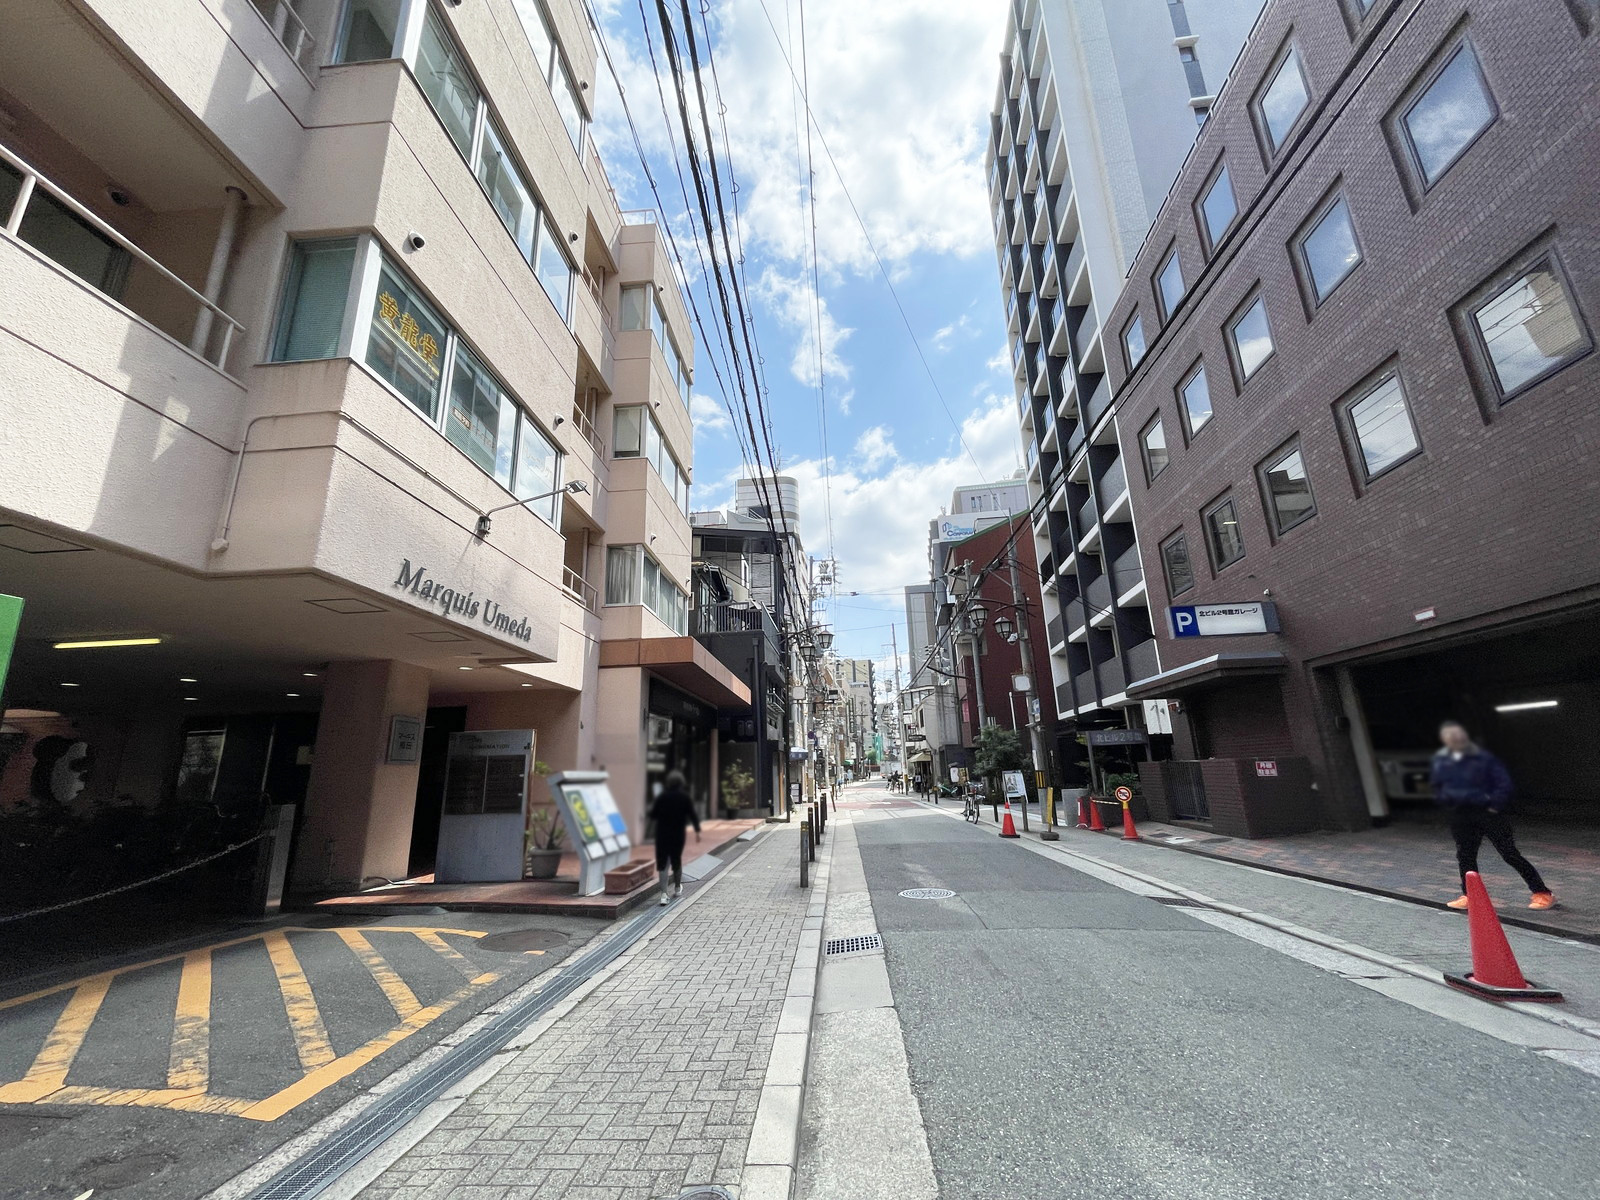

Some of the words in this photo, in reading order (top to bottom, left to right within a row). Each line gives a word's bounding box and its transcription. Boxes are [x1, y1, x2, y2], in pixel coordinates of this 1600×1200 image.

[394, 558, 480, 617] Marquis
[483, 599, 532, 641] Umeda
[1175, 612, 1193, 633] P
